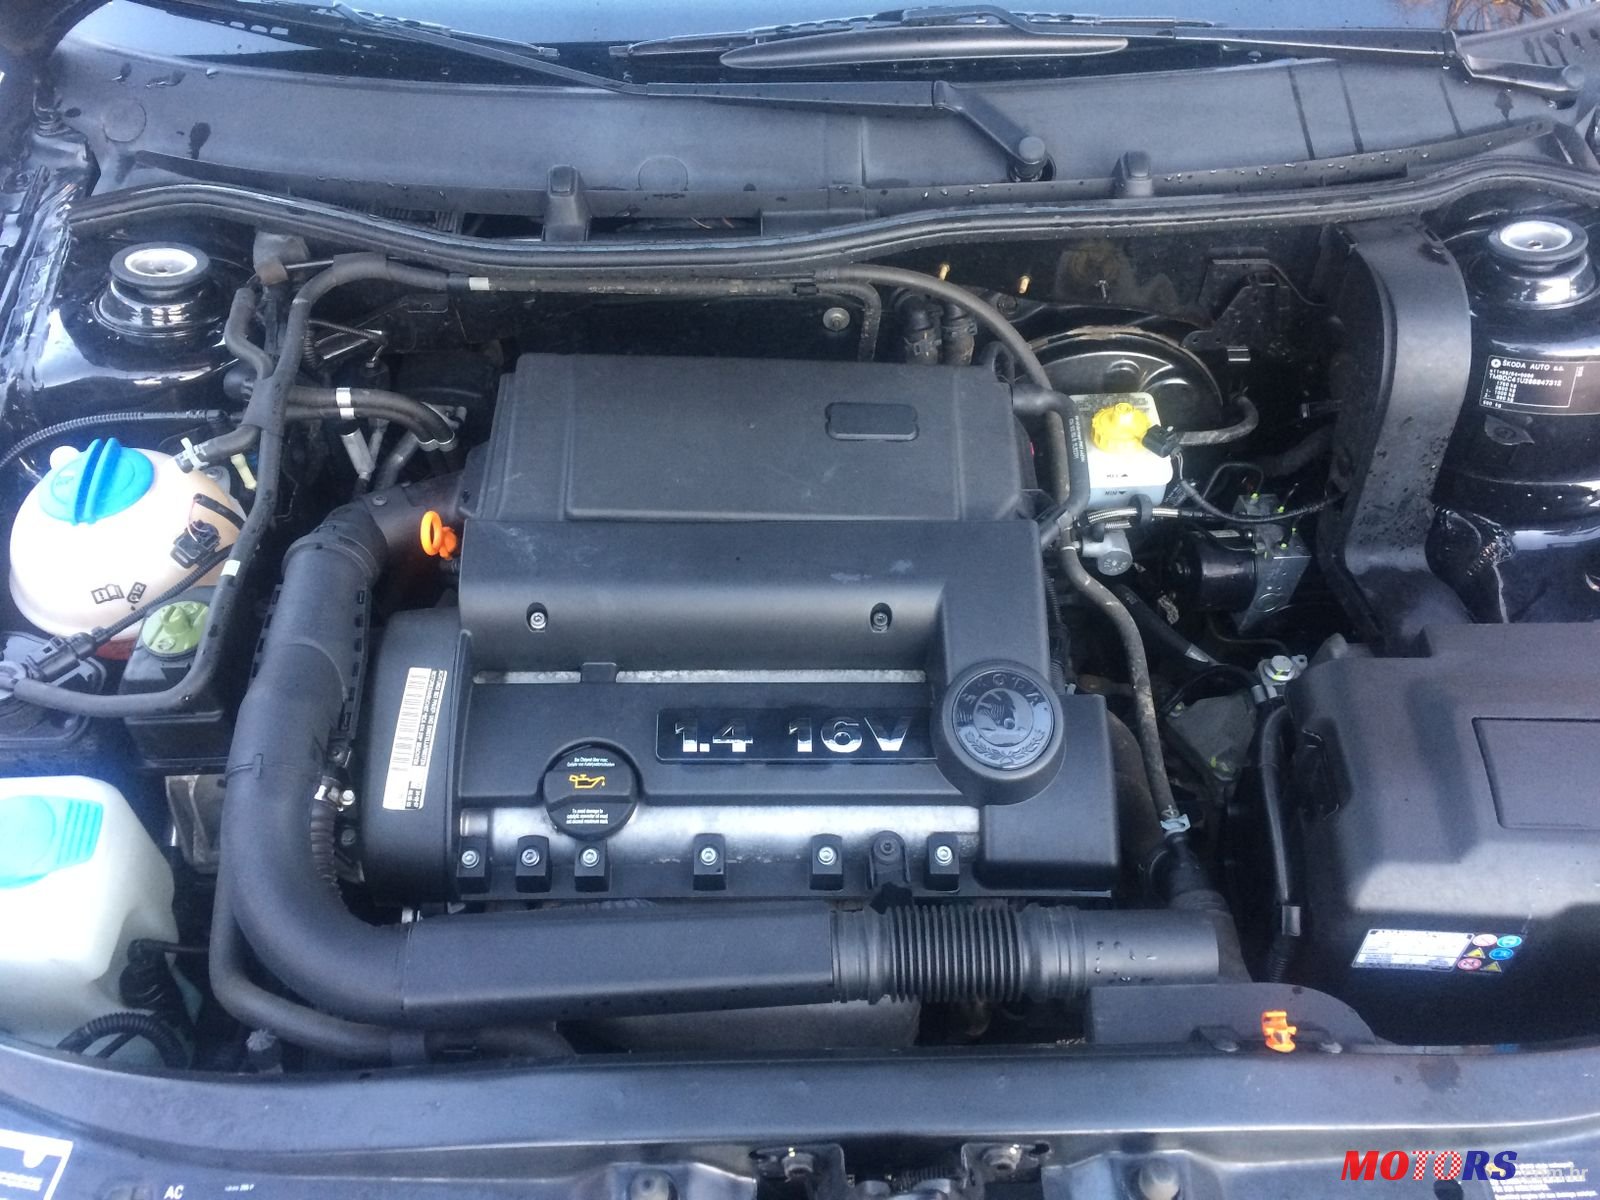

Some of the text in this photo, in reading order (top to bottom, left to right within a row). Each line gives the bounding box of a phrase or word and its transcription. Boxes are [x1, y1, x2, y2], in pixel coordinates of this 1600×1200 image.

[1530, 363, 1550, 371] AUTO
[674, 716, 914, 753] 1.4 16V
[163, 1184, 185, 1200] AC
